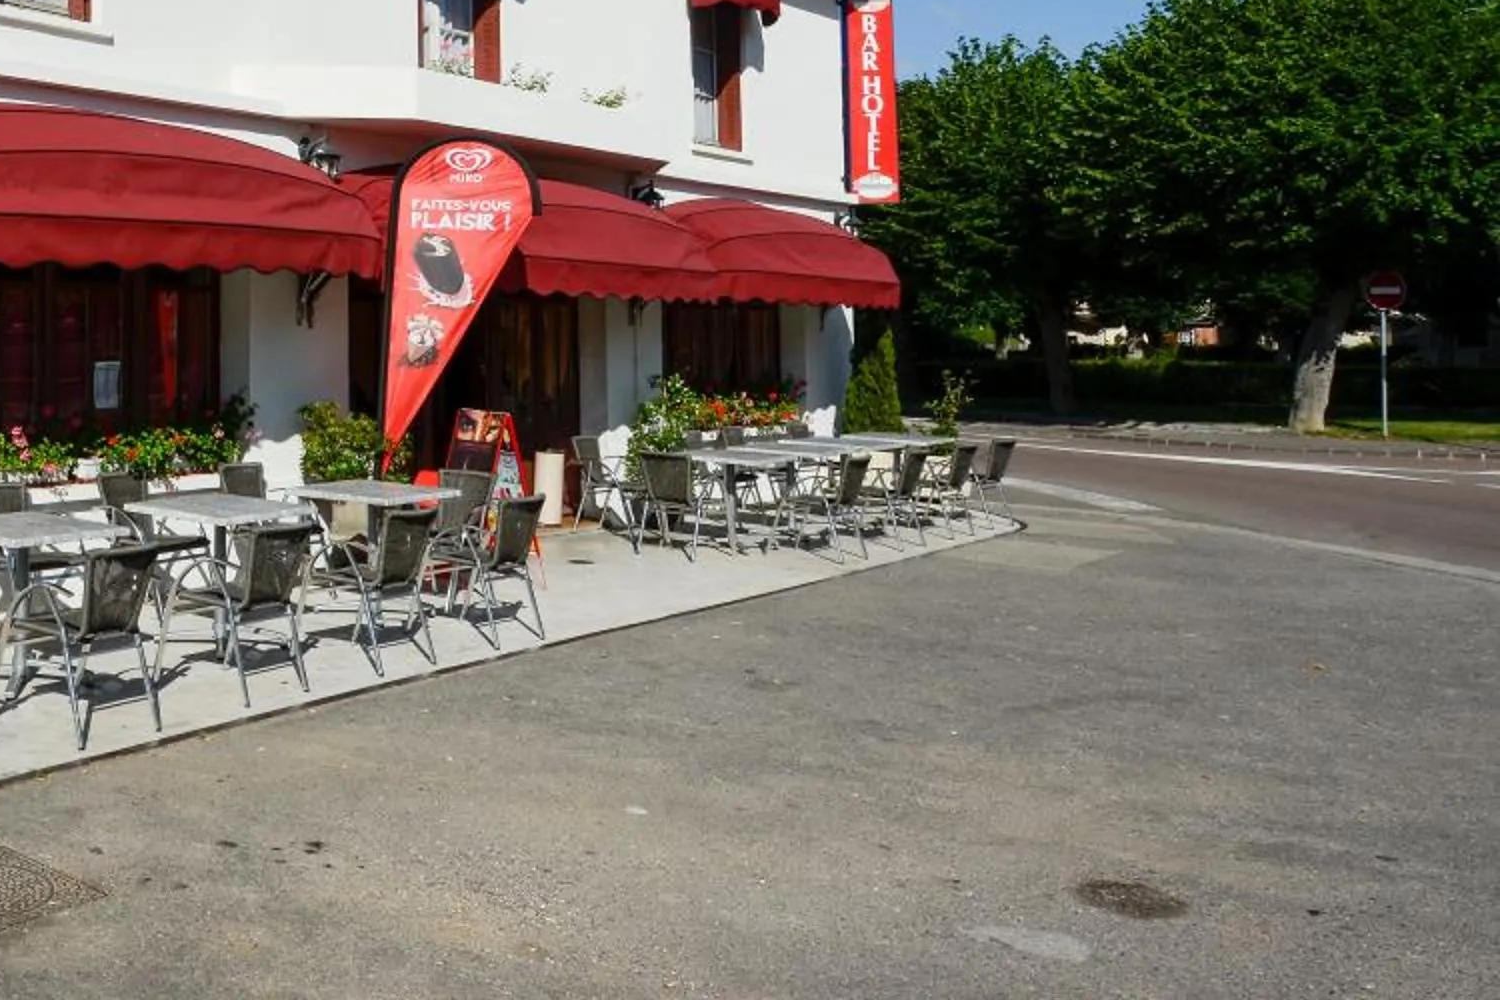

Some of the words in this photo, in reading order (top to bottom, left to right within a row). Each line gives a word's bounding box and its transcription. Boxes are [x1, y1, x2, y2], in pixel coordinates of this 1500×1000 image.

[861, 13, 881, 71] BAR
[861, 75, 884, 171] HOTEL
[411, 199, 512, 211] FAITES-VOUS
[411, 211, 495, 232] PLAISIR
